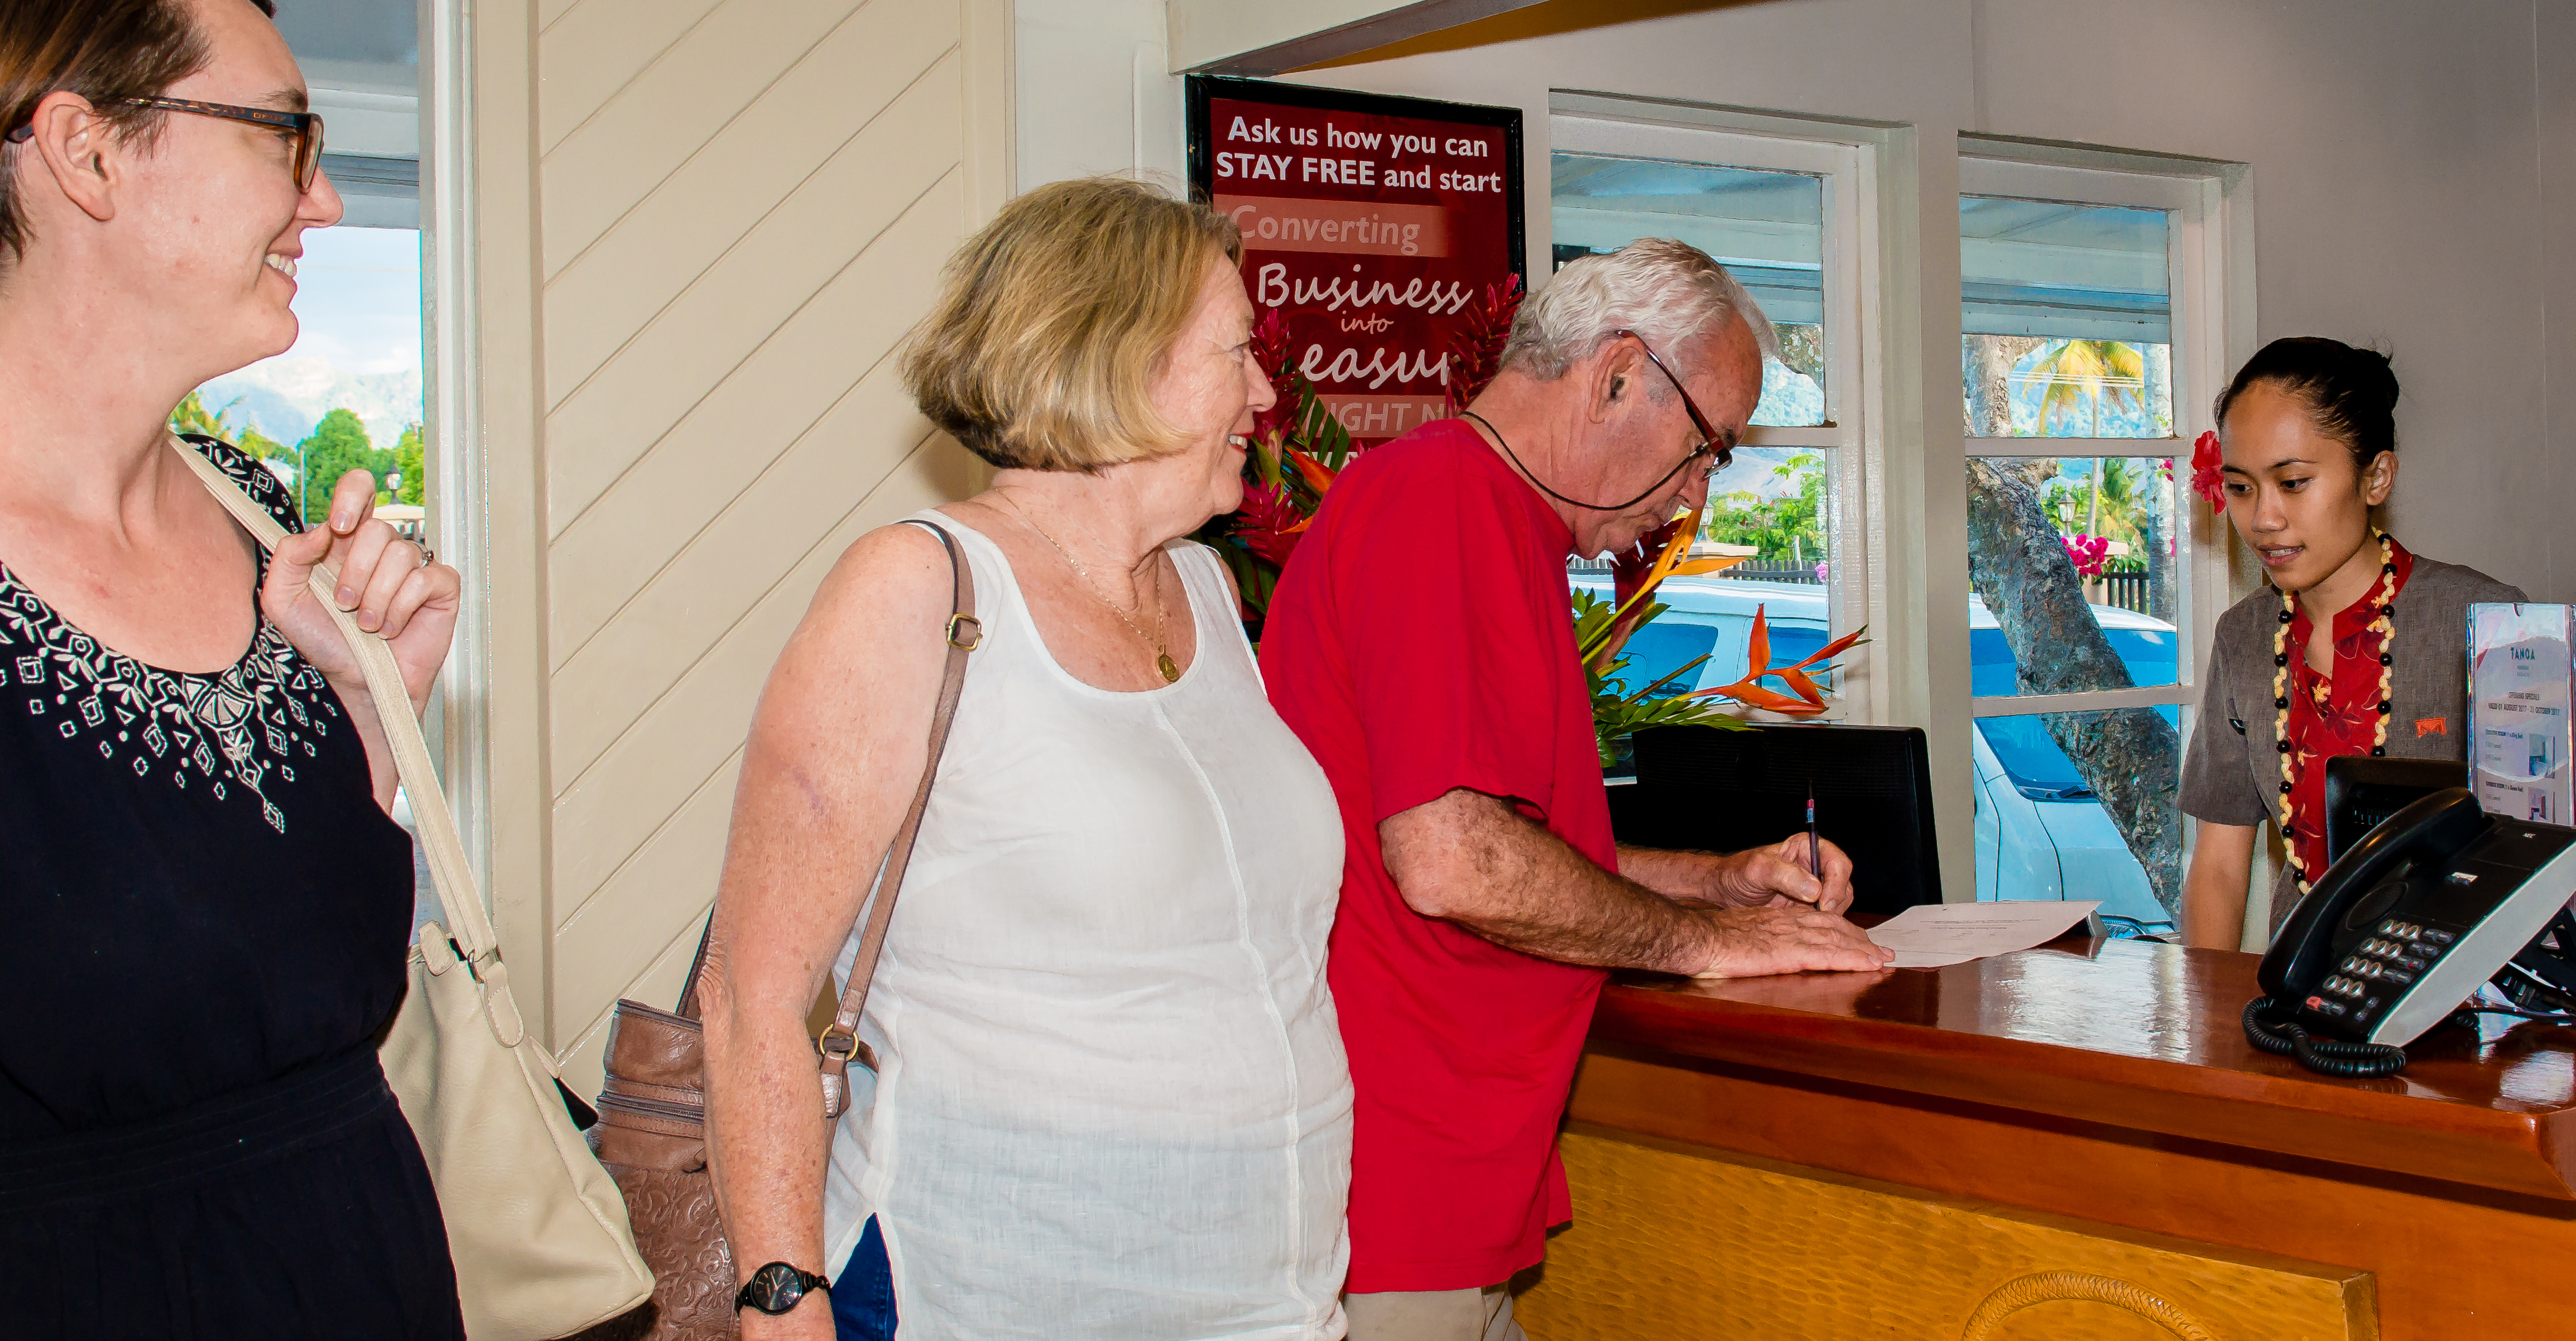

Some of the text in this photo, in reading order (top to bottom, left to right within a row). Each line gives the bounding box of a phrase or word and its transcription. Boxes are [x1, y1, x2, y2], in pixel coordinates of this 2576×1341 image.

[1228, 116, 1488, 158] Ask us how you can
[1217, 152, 1501, 193] STAY FREE and start
[1231, 204, 1421, 256] Converting
[1258, 263, 1473, 315] Business
[1341, 310, 1394, 334] into
